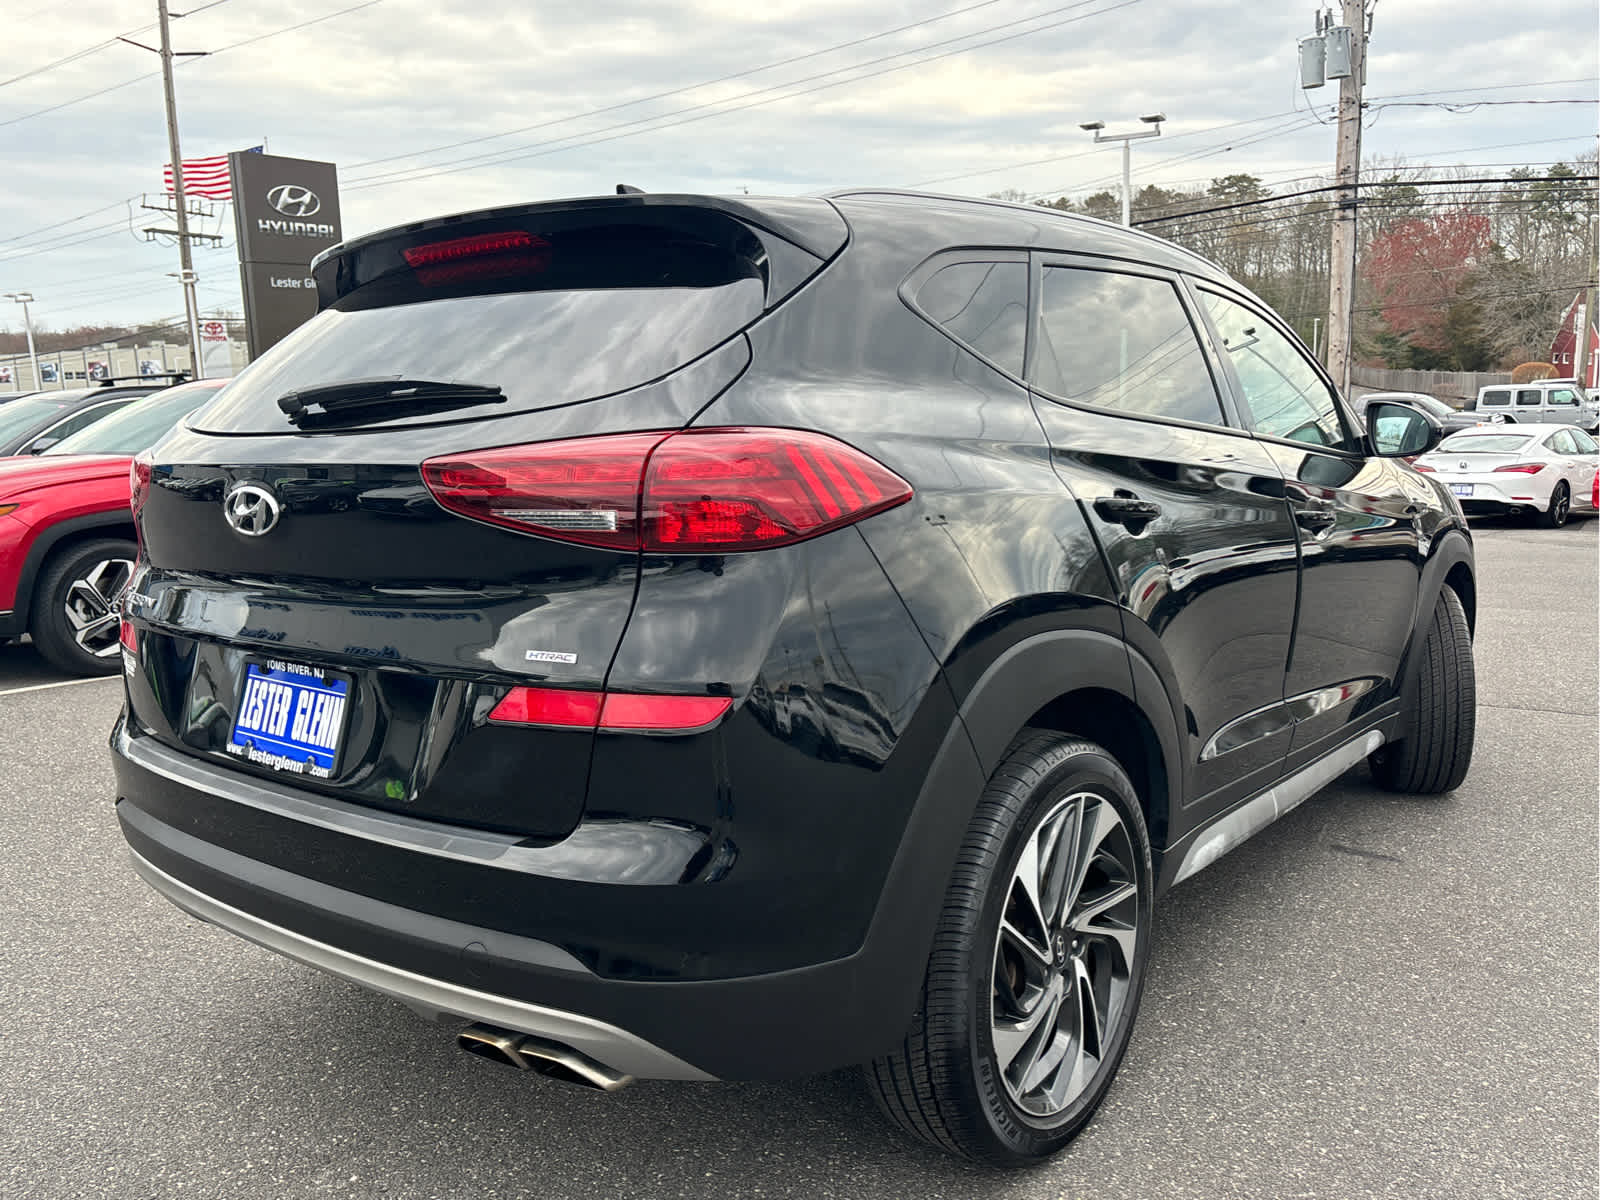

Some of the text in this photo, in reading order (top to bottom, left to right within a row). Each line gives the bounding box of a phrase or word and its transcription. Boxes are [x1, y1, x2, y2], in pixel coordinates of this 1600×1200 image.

[258, 219, 334, 237] HYUNDAI
[270, 277, 301, 288] Lester
[528, 651, 574, 662] HTRAC
[267, 660, 286, 672] TOMS
[313, 667, 325, 679] NJ
[238, 678, 346, 750] LESTER GLENN
